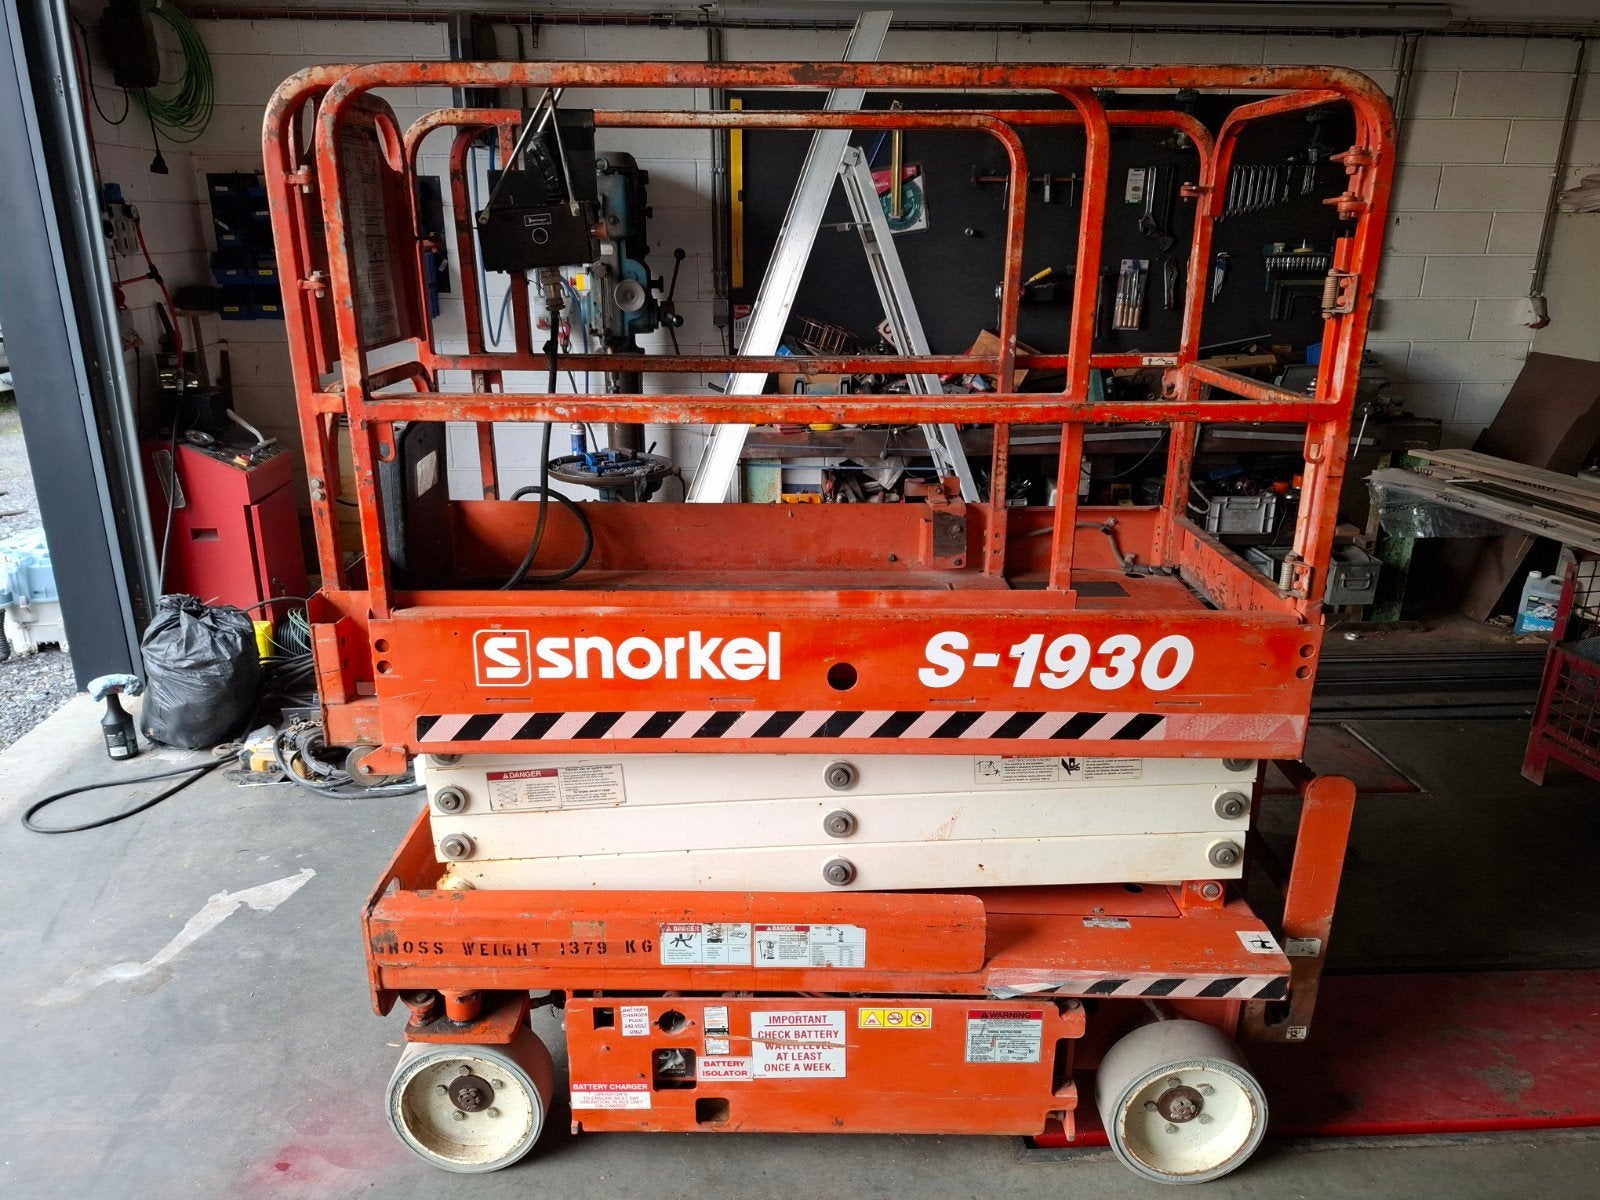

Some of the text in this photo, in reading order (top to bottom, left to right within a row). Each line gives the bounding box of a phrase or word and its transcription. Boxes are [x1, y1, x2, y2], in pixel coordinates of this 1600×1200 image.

[531, 630, 781, 681] snorkel
[918, 631, 1194, 691] S-1930
[509, 770, 541, 778] DANGER
[463, 942, 541, 956] WEIGHT
[560, 941, 607, 954] 1379
[625, 940, 653, 953] KG
[769, 1015, 828, 1024] IMPORTANT
[758, 1029, 839, 1039] CHECK BATTERY
[776, 1052, 822, 1060] AT LEAST
[764, 1062, 835, 1072] ONCE A WEEK.
[702, 1069, 748, 1077] ISOLATOR
